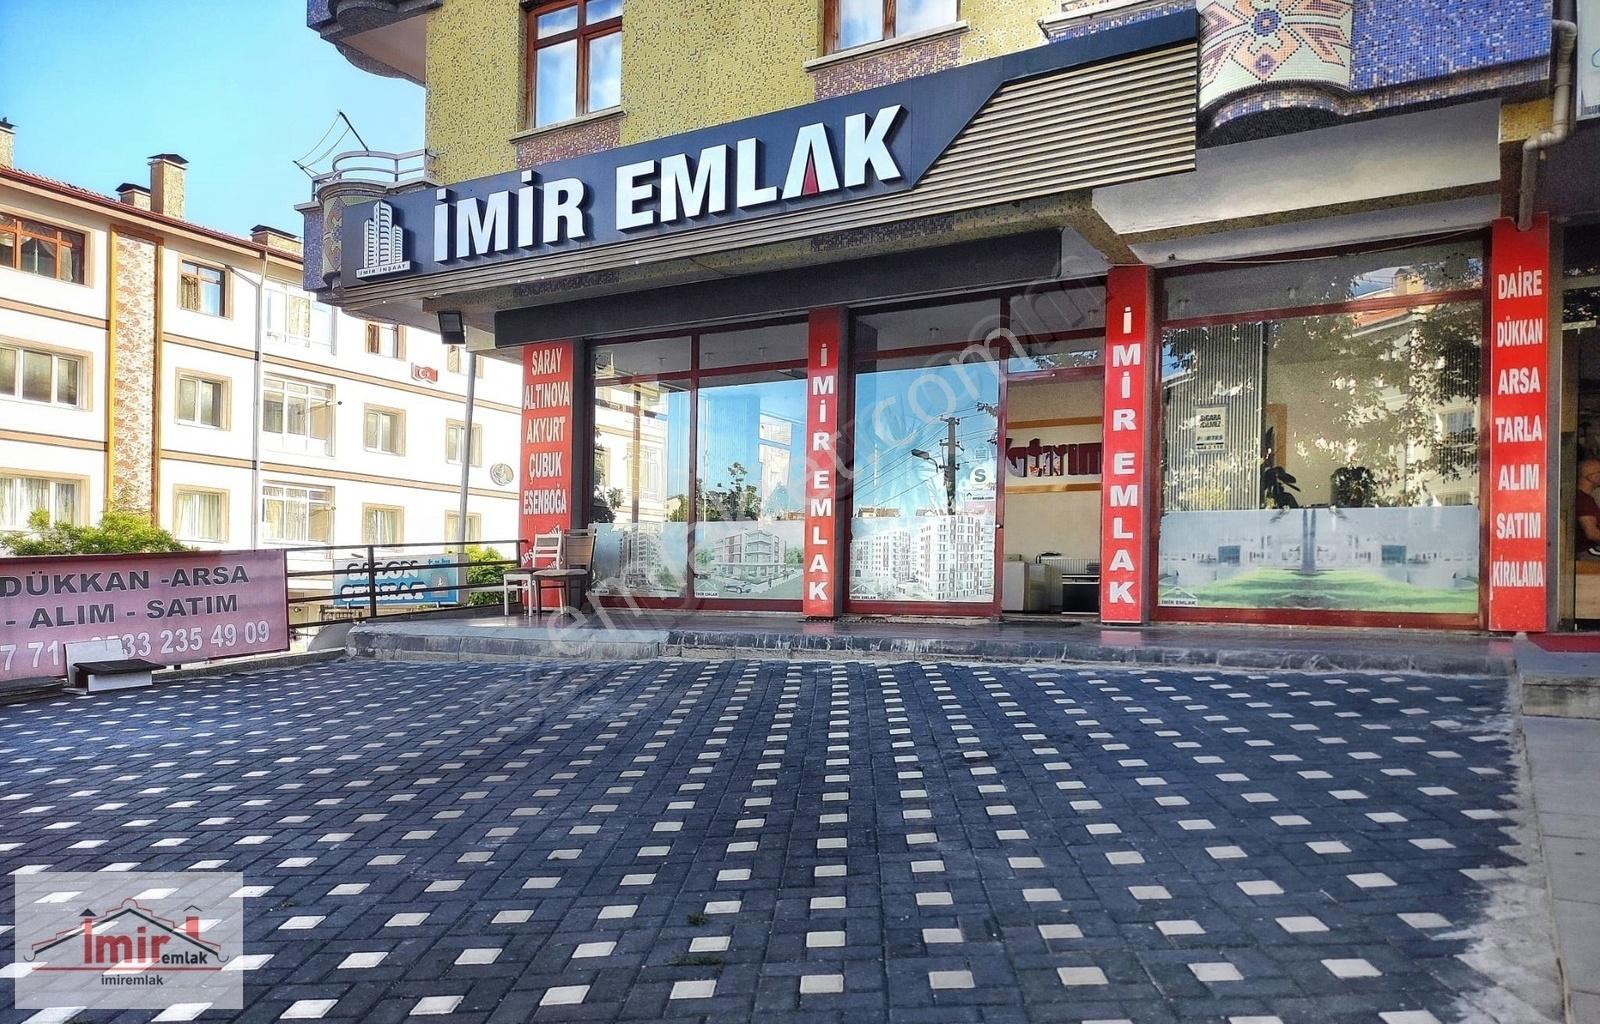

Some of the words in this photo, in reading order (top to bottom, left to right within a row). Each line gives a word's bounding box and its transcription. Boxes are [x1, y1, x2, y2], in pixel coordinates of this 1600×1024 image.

[434, 169, 588, 262] İMİR
[616, 105, 903, 231] EMLAK
[1498, 265, 1543, 300] DAİRE
[1496, 315, 1543, 348] DÜKKAN
[531, 347, 563, 376] SARAY
[1111, 306, 1141, 432] İMİR
[523, 381, 570, 410] ALTINOVA
[812, 343, 834, 452] İMİR
[1497, 366, 1541, 396] ARSA
[526, 416, 566, 443] AKYURT
[1495, 415, 1543, 443] TARLA
[529, 452, 562, 485] ÇUBUK
[1498, 463, 1540, 491] ALIM
[523, 482, 567, 515] ESENBOĞA
[808, 469, 832, 601] EMLAK
[1109, 452, 1139, 604] EMLAK
[1496, 512, 1541, 539] SATIM
[0, 570, 150, 598] DÜKKAN
[1492, 555, 1544, 588] KİRALAMA
[29, 603, 115, 629] ALIM
[147, 594, 238, 619] SATIM
[27, 640, 59, 668] 71
[160, 627, 203, 654] 235
[210, 623, 237, 648] 49
[244, 620, 270, 645] 09
